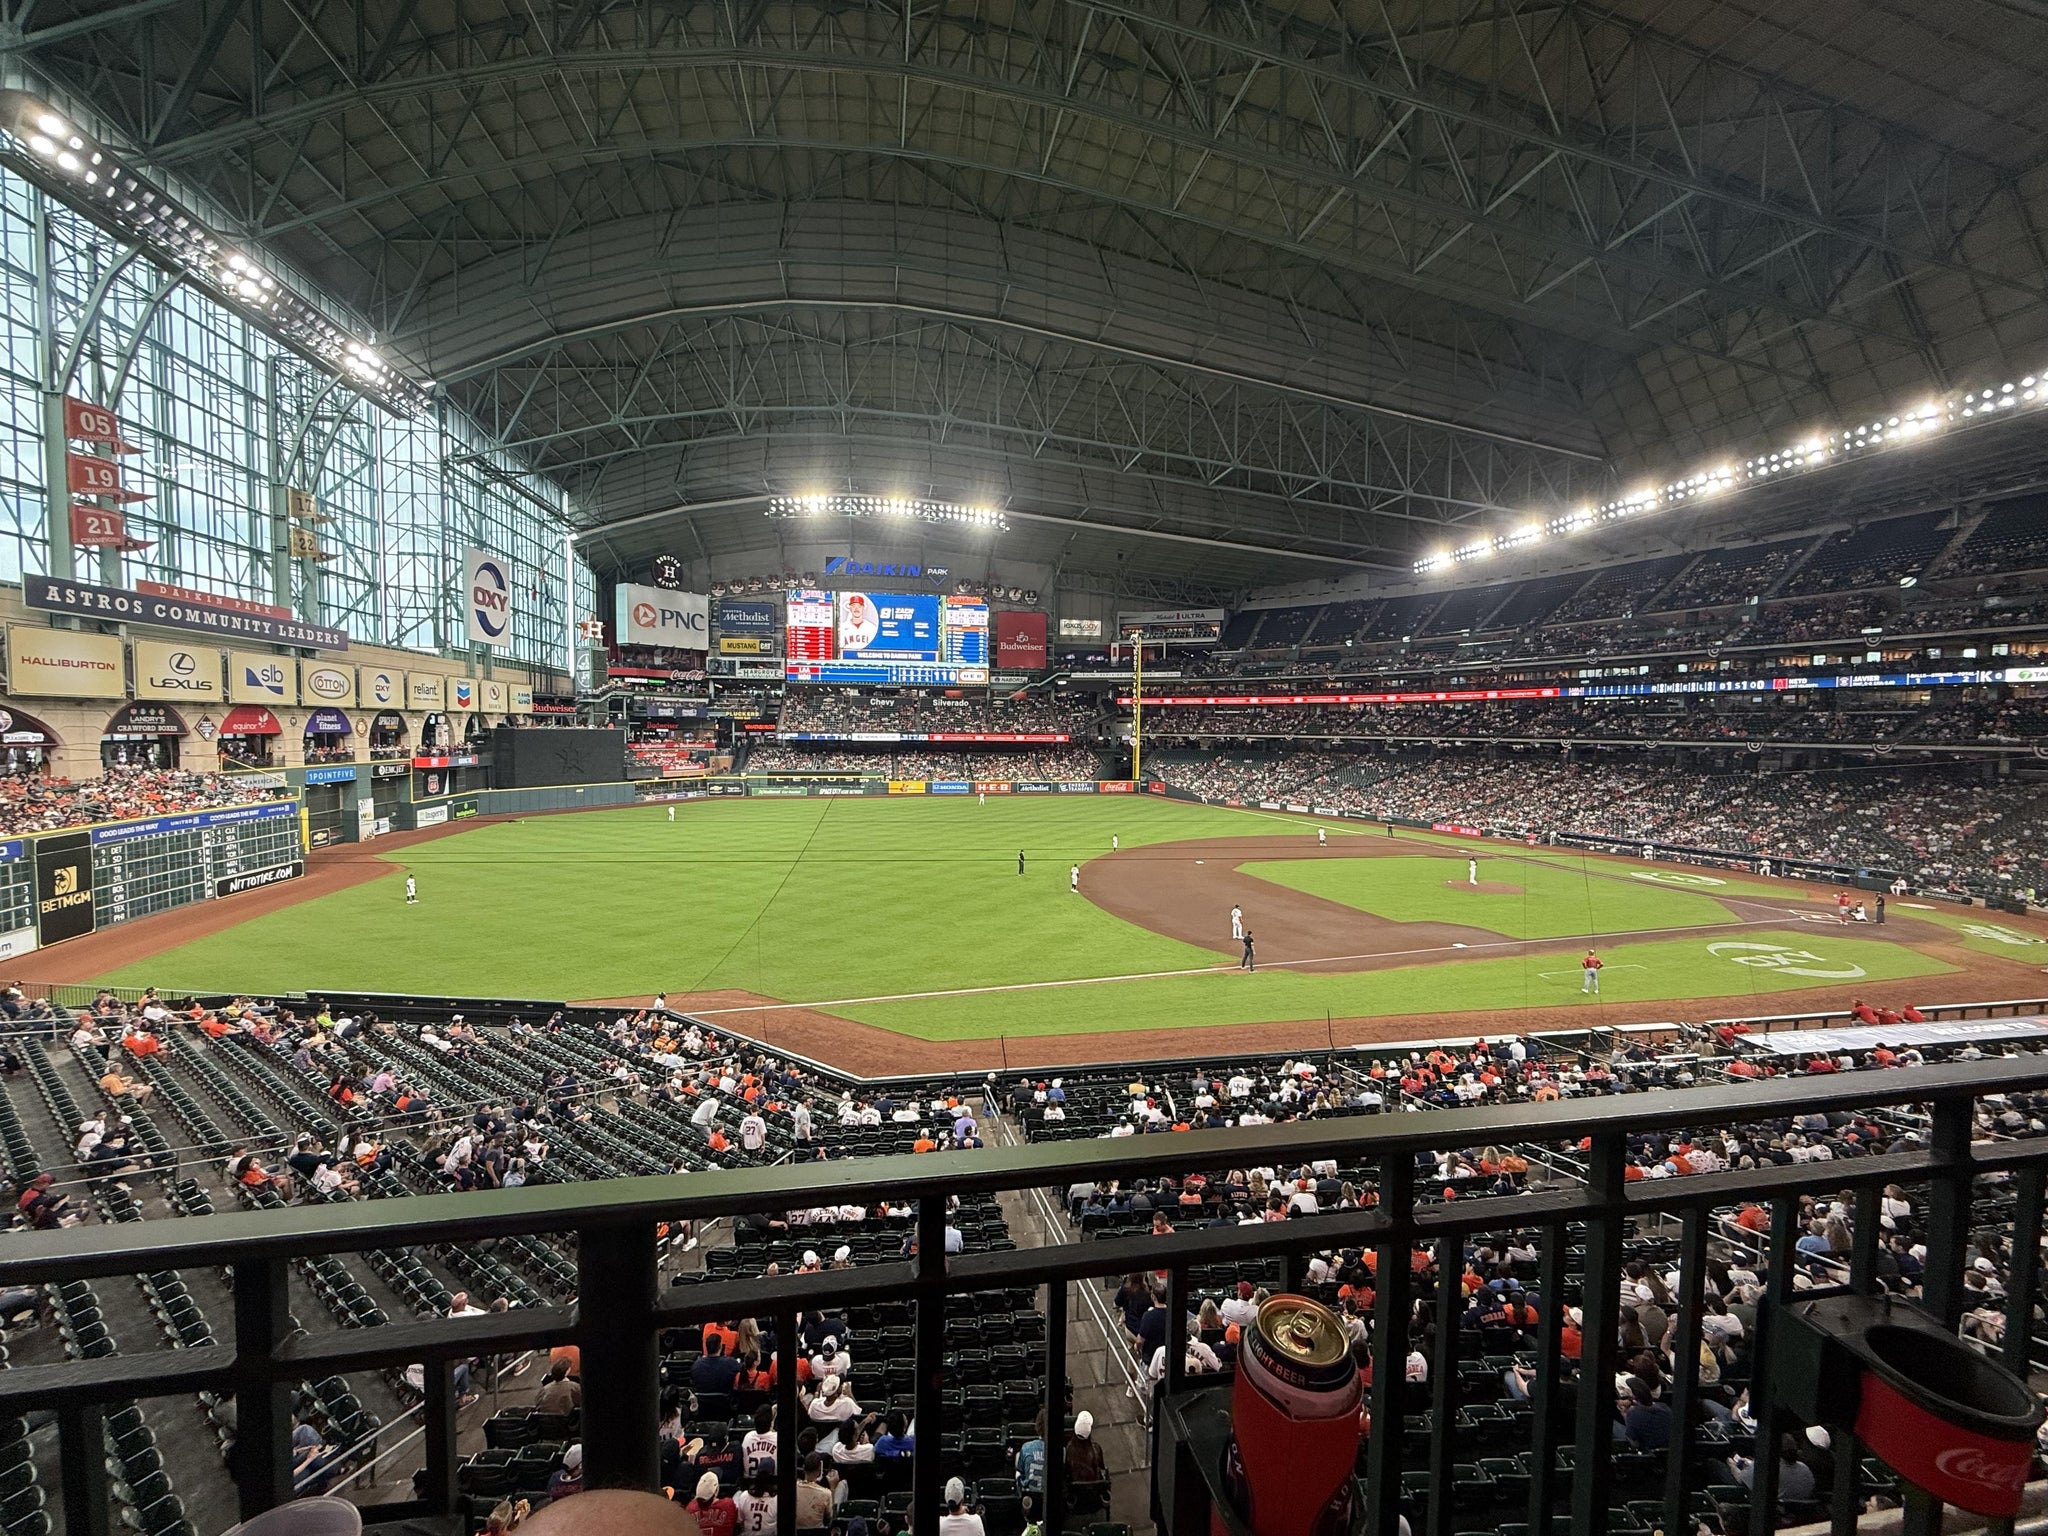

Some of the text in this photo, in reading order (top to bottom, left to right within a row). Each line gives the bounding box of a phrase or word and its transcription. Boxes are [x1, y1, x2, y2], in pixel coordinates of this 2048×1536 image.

[80, 411, 111, 435] 05
[85, 466, 114, 487] 19
[296, 497, 312, 513] 17
[86, 516, 115, 535] 21
[299, 537, 314, 551] 22
[664, 565, 675, 578] H
[846, 562, 949, 577] DAIKIN PARK
[160, 586, 272, 615] DAIKIN PARK
[473, 586, 508, 612] OXY
[46, 585, 339, 645] ASTROS COMMUNITY LEADERS
[659, 607, 706, 632] PNC
[722, 611, 770, 621] Methodist
[588, 621, 603, 638] H
[1000, 642, 1044, 650] Budweiser
[21, 655, 116, 671] HALLIBURTON
[261, 663, 284, 684] slb
[743, 669, 779, 677] HARGROVE
[1981, 671, 1993, 683] K
[150, 676, 213, 691] LEXUS
[314, 674, 345, 693] COTTON
[375, 684, 390, 692] OXY
[414, 683, 436, 695] reliant
[532, 703, 576, 713] Budweiser
[870, 698, 969, 707] Chevy Silverado
[315, 713, 338, 724] planet
[319, 720, 342, 730] fitness
[232, 723, 258, 731] equinor
[309, 769, 354, 780] 1POINTFIVE
[225, 812, 238, 820] LEADS
[238, 810, 249, 818] THE
[249, 809, 260, 817] WAY
[170, 819, 193, 827] UNITED
[99, 823, 159, 839] GOOD LEADS THE WAY
[225, 827, 236, 835] CLE
[111, 847, 122, 855] DET
[229, 866, 293, 893] NITTOTIRE.COM
[41, 891, 91, 914] BETMGM
[113, 905, 125, 913] TEX
[25, 918, 31, 926] 0
[113, 914, 125, 922] PHI
[1731, 950, 1827, 968] OXY
[1233, 1083, 1244, 1092] 44
[745, 1126, 756, 1136] 27
[791, 1214, 805, 1224] 27
[1250, 1338, 1306, 1386] LIGHT BEER
[746, 1441, 777, 1456] ALTUVE
[750, 1500, 769, 1513] PEÑA
[752, 1513, 763, 1532] 3
